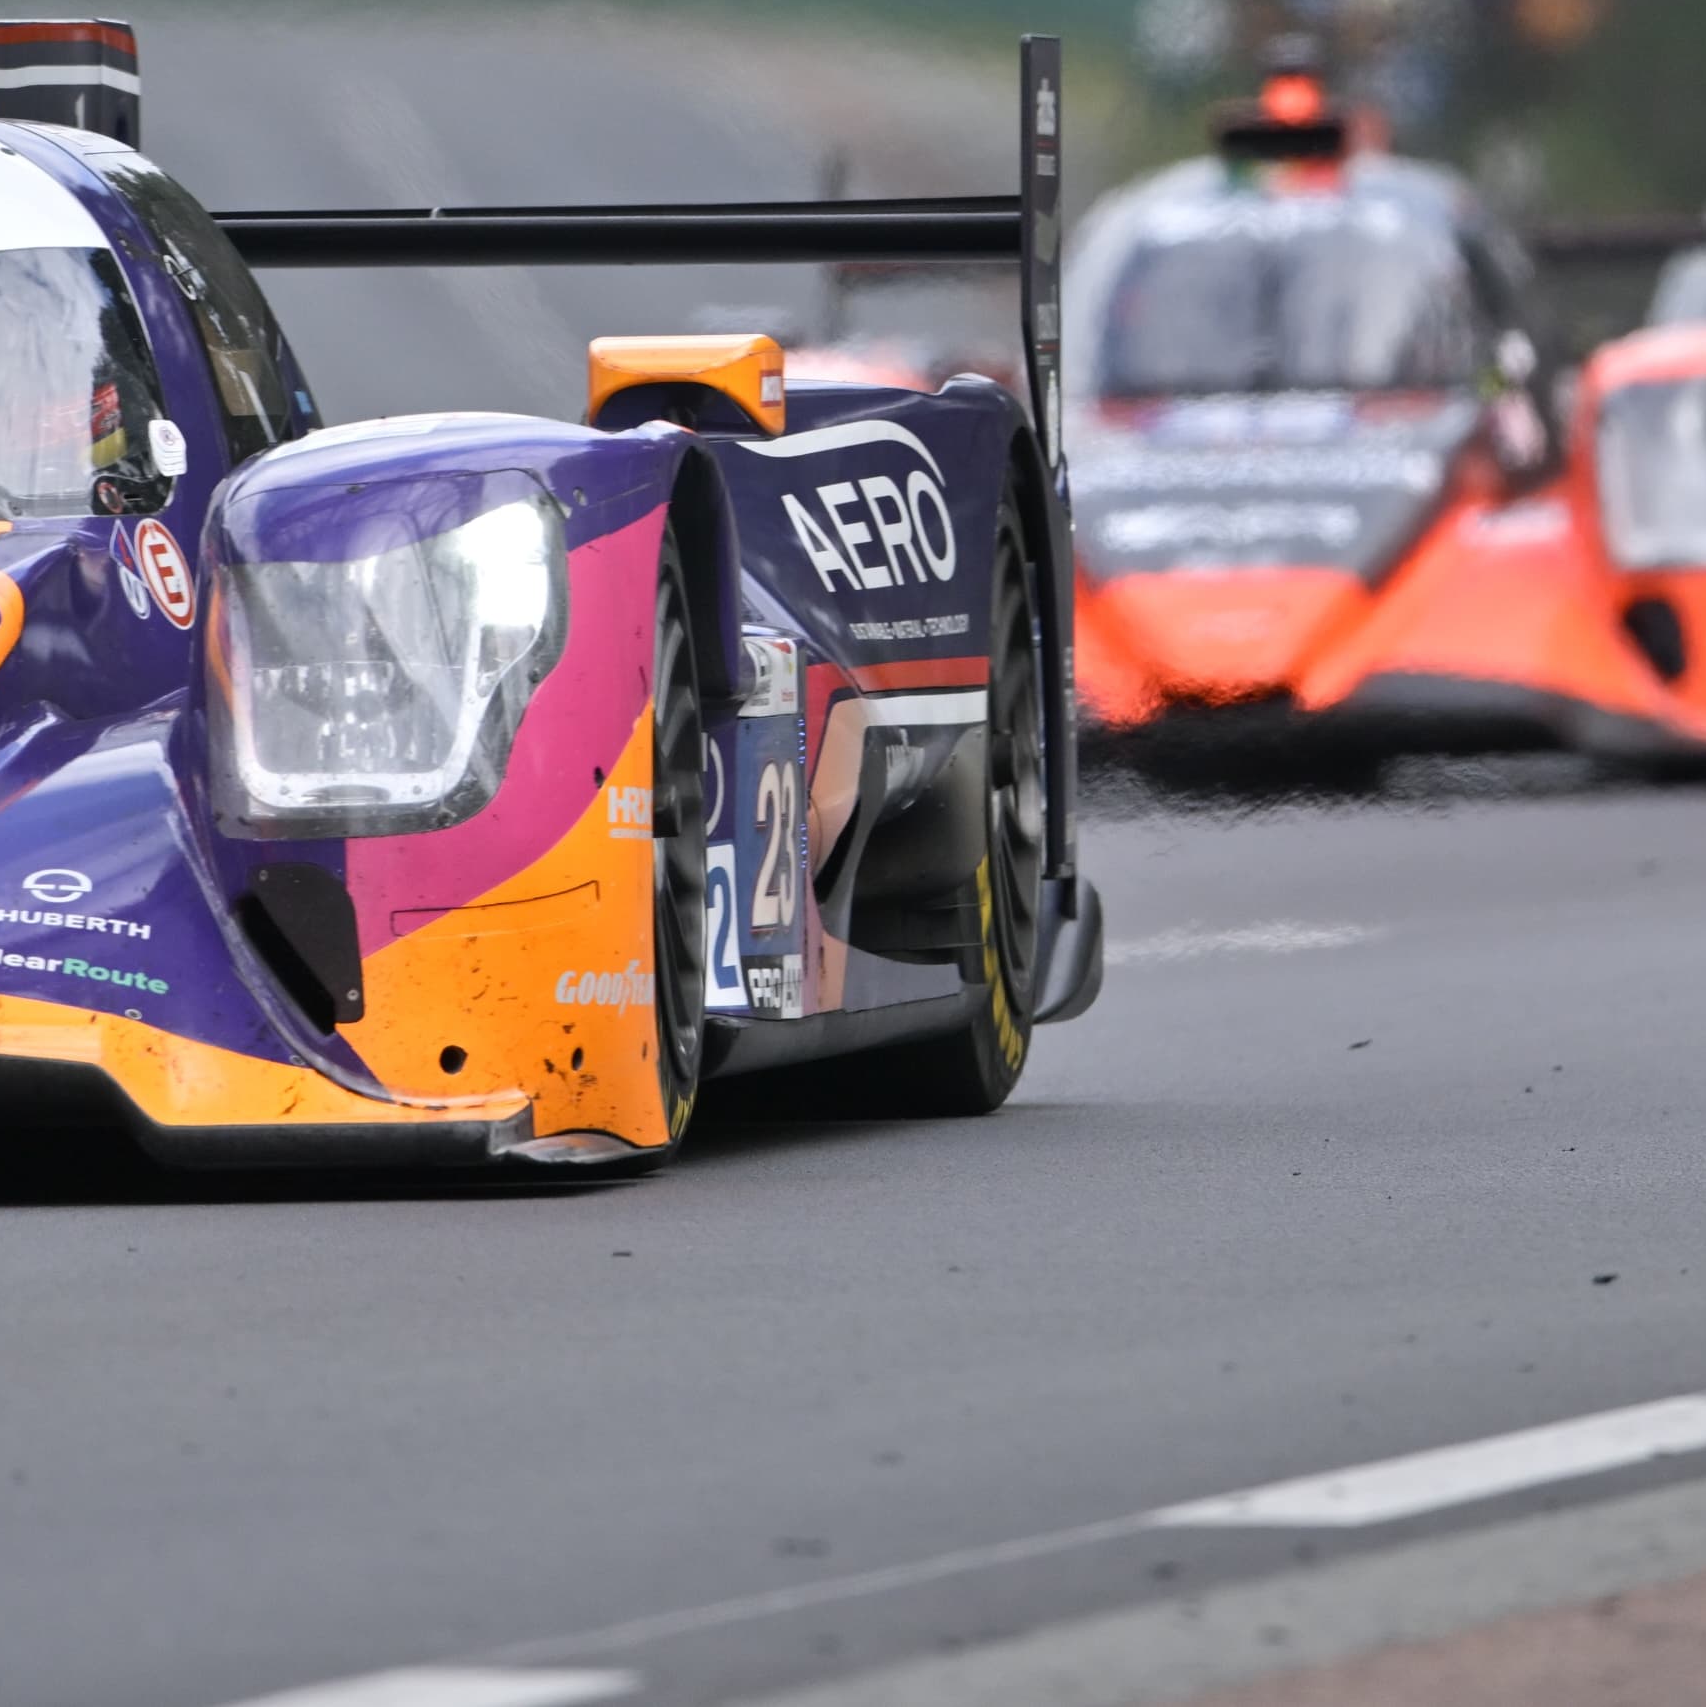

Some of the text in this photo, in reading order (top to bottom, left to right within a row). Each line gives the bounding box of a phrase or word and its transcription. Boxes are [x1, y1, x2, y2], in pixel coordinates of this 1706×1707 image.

[781, 470, 957, 593] AERO
[752, 760, 797, 928] 23
[748, 968, 781, 1008] PRO
